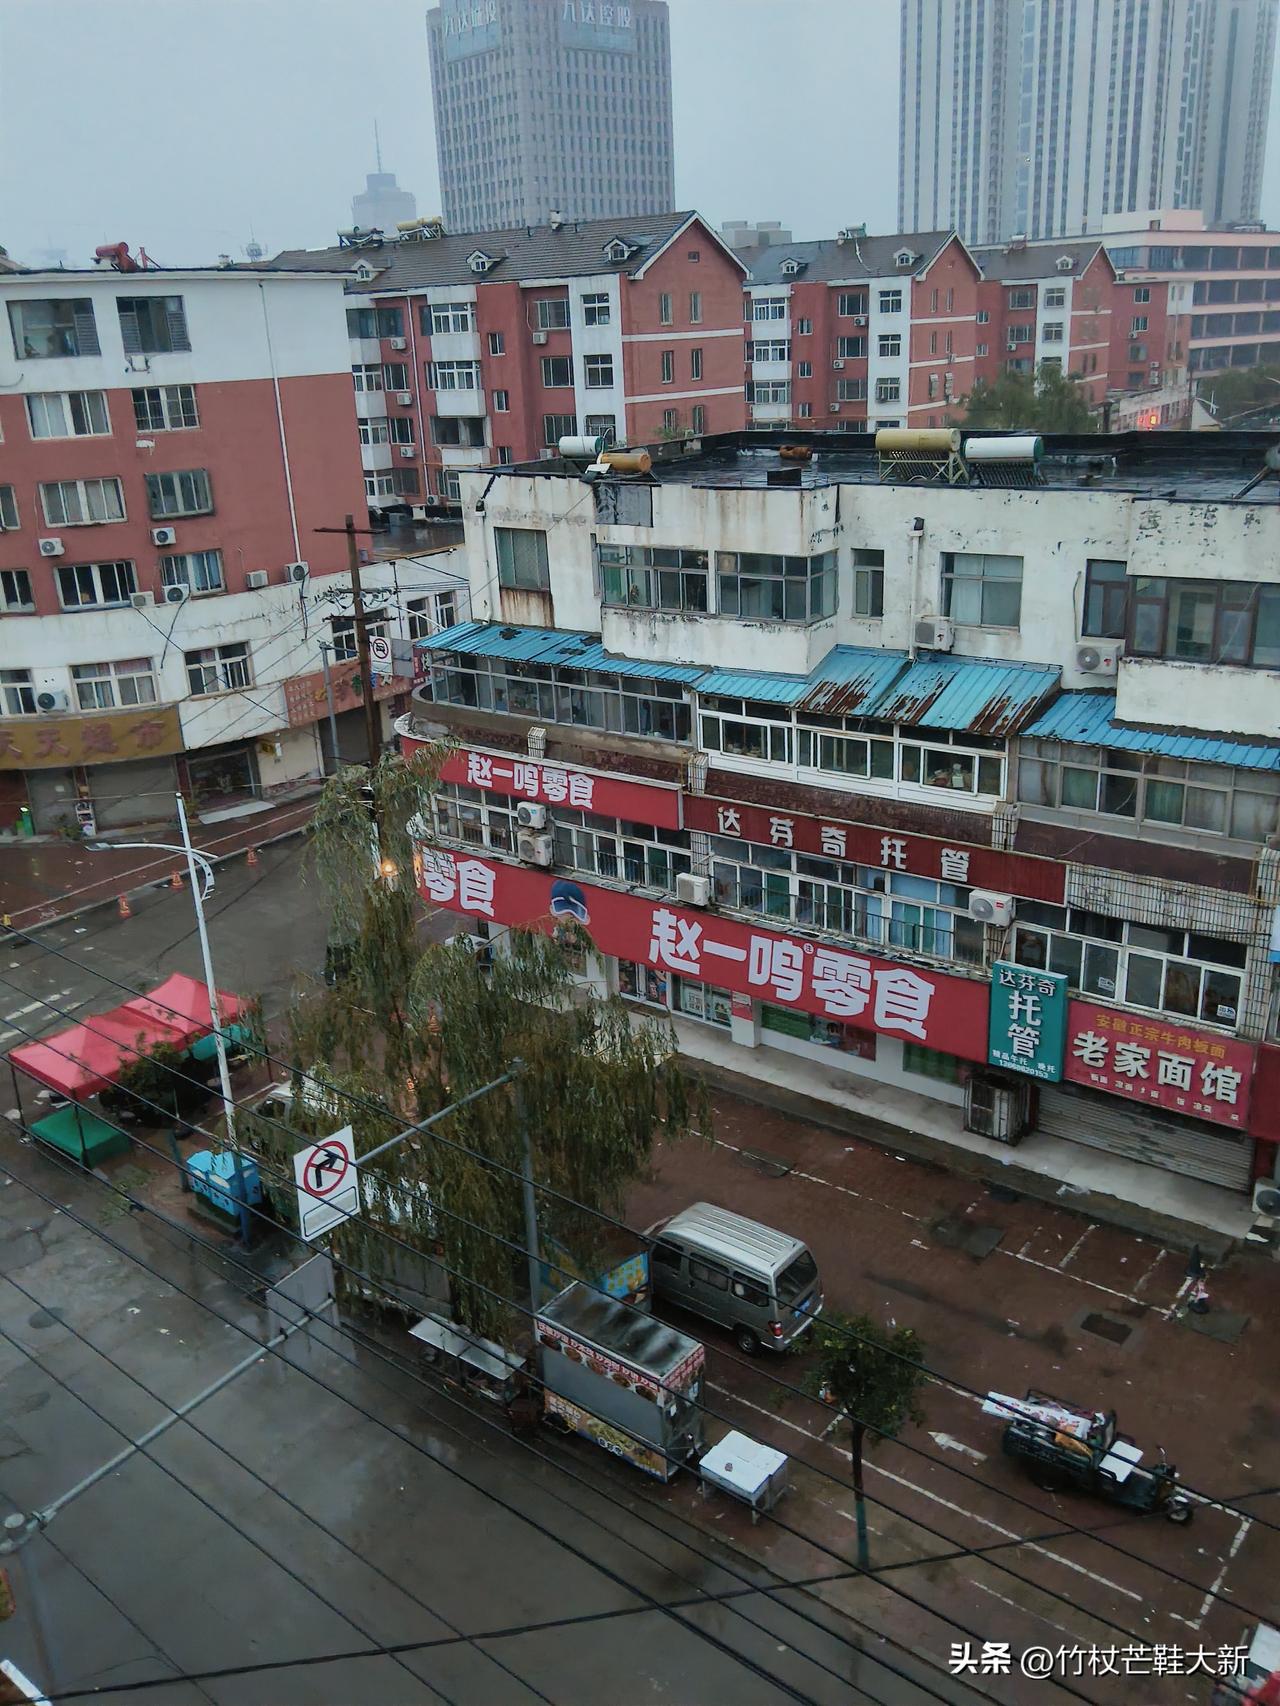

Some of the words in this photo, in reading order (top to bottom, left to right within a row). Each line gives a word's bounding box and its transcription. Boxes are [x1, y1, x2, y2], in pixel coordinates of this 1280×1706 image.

[466, 752, 595, 810] 赵一鸣零食
[717, 806, 971, 883] 达芬奇托管
[423, 846, 496, 917] 零食
[648, 908, 936, 1041] 赵一鸣零食
[999, 968, 1057, 997] 达芬奇
[1007, 990, 1041, 1059] 托管
[1072, 1030, 1243, 1105] 老家面馆
